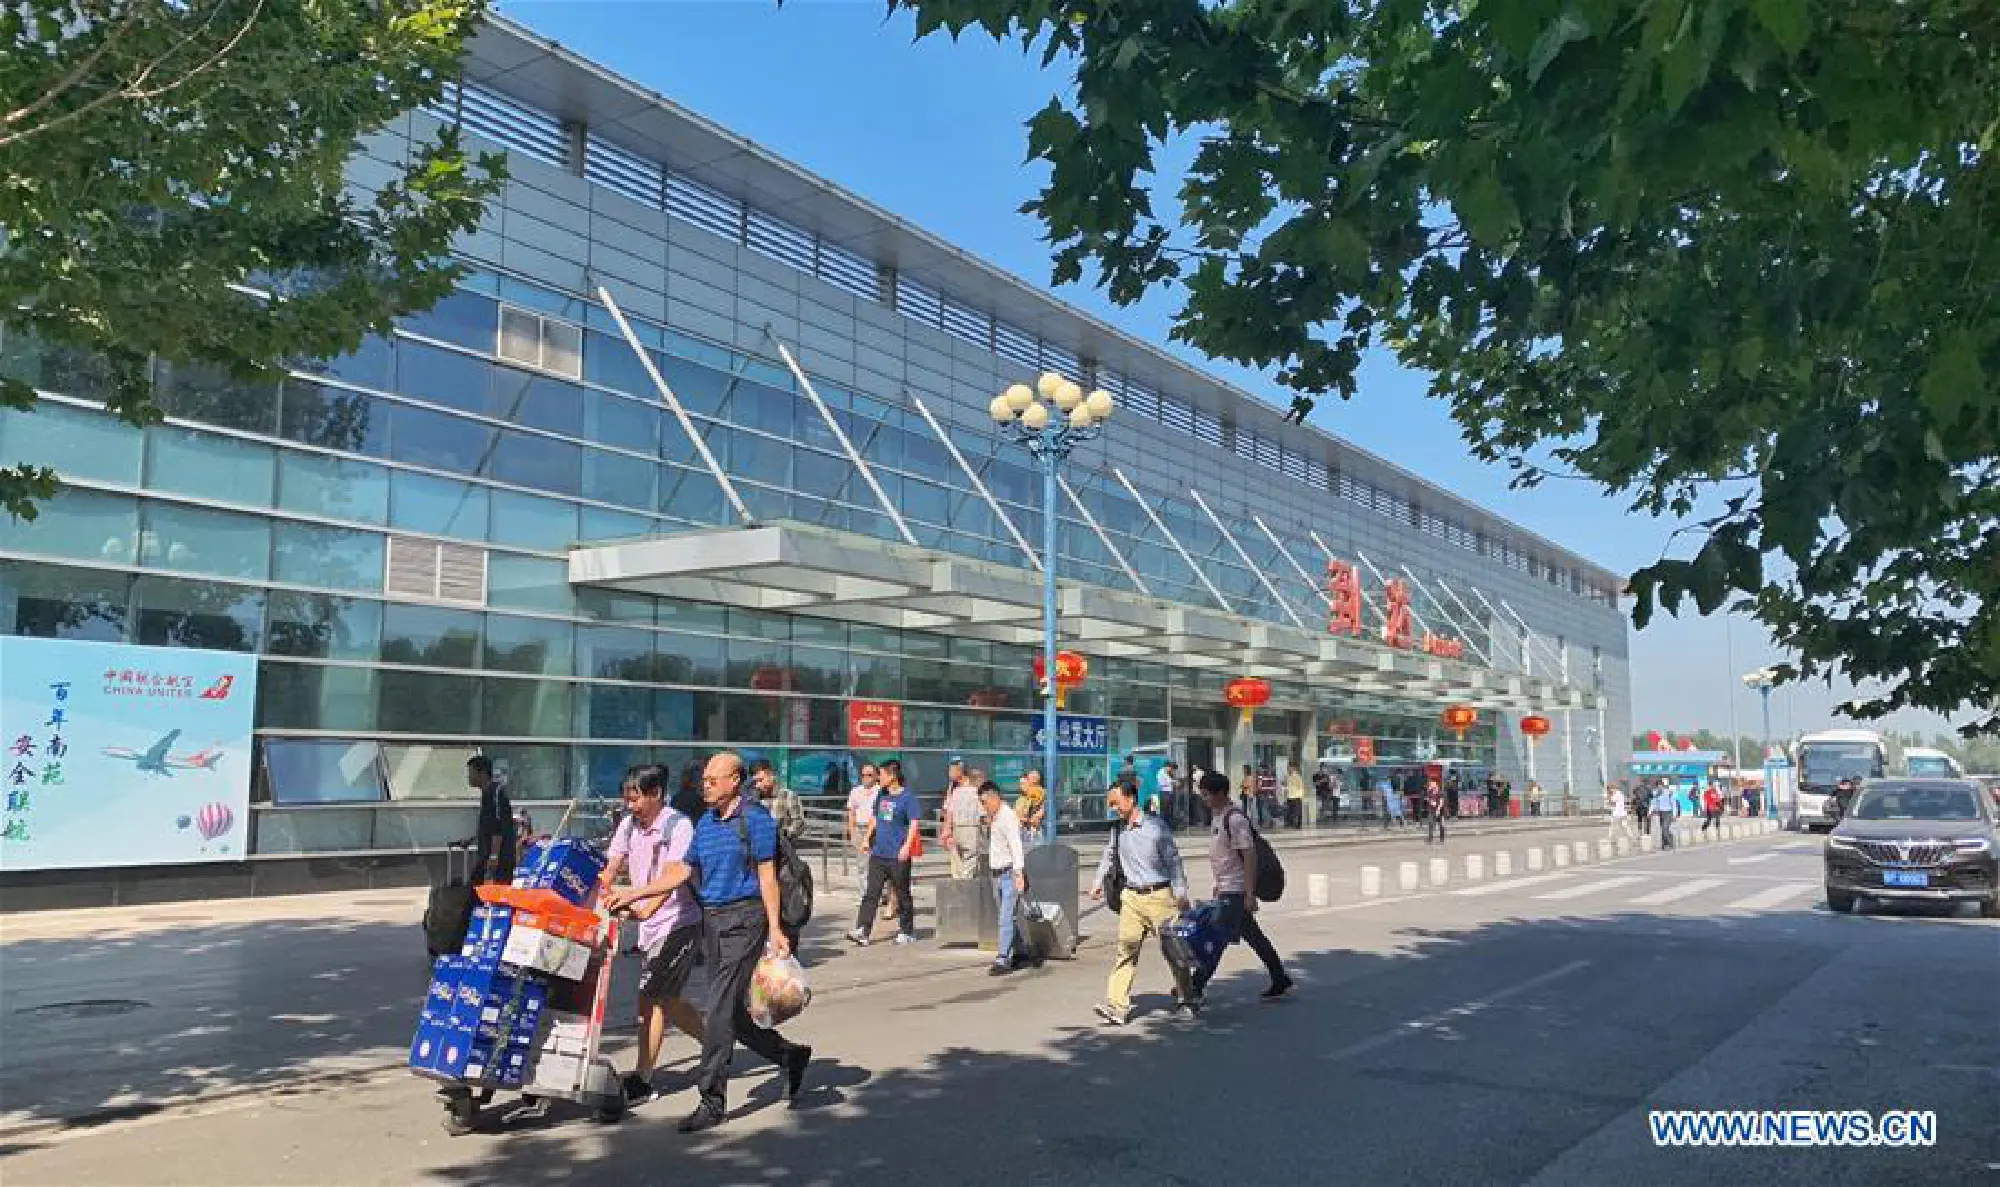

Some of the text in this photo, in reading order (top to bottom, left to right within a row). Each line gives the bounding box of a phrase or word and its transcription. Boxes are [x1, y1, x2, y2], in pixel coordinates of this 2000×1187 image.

[42, 682, 71, 787] 百年南苑
[0, 734, 37, 842] 安全联航
